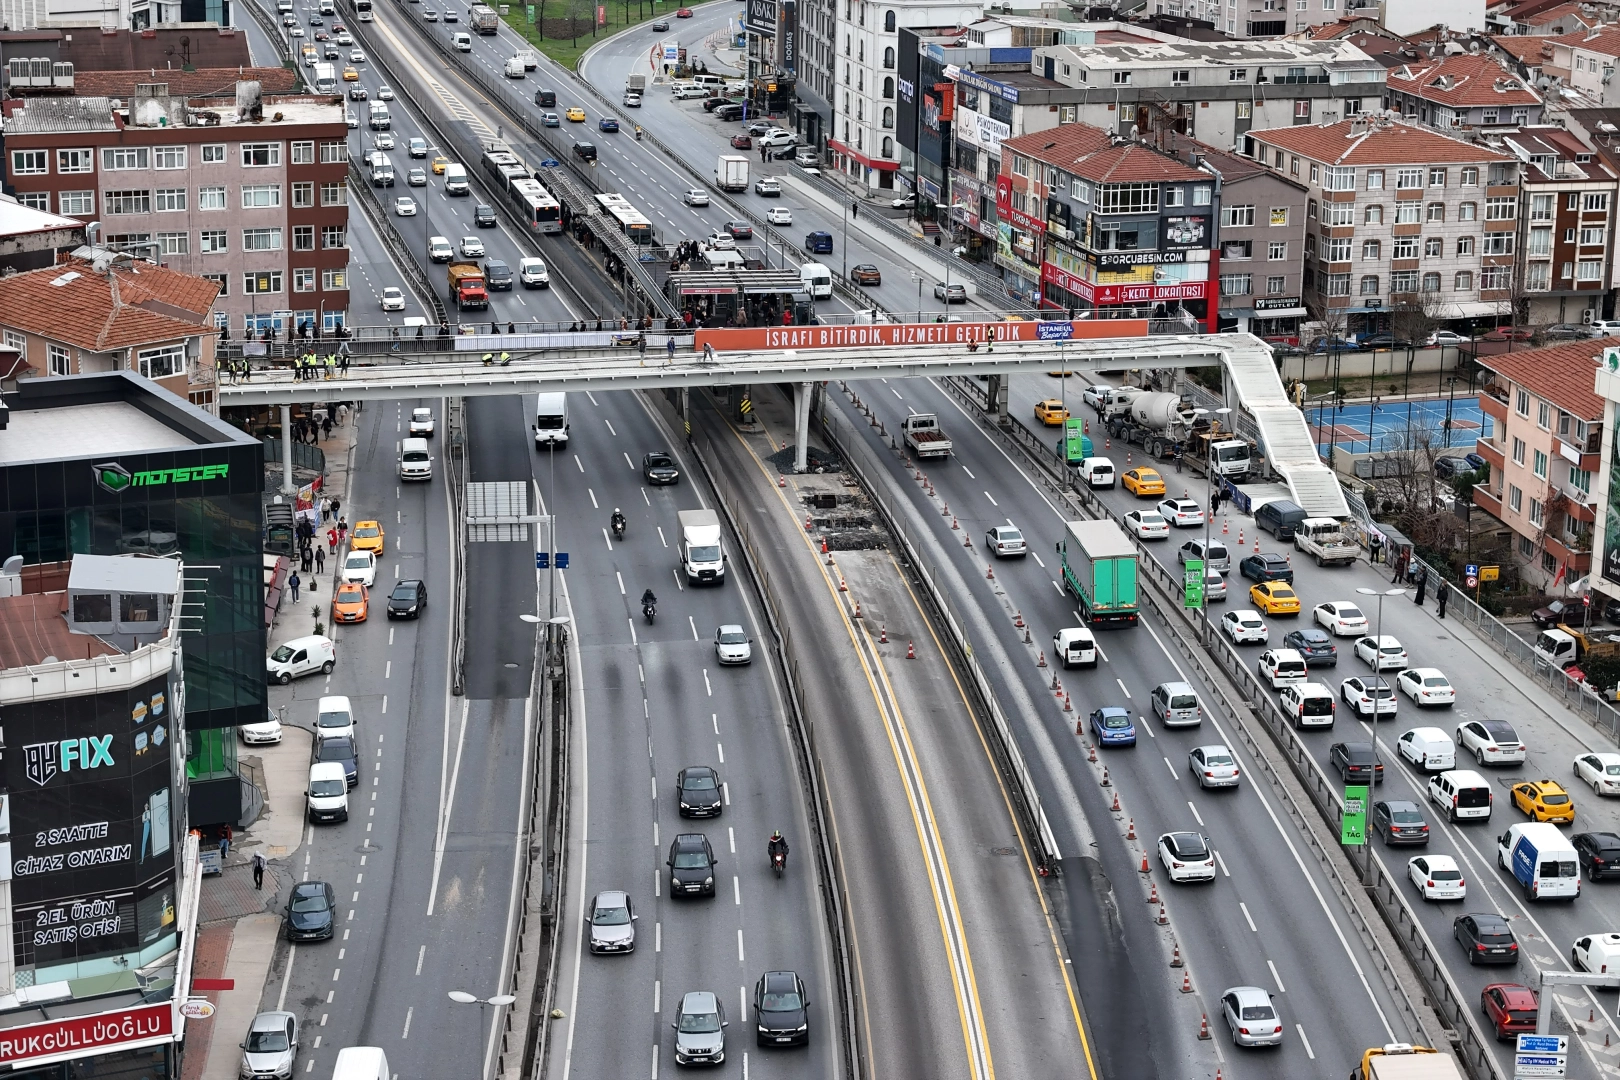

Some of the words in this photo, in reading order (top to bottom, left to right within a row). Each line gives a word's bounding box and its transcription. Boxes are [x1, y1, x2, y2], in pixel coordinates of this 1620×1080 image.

[785, 31, 793, 61] DOĞTAŞ
[898, 74, 914, 98] bambi
[976, 116, 1009, 137] PSİKOTEKNİK
[1128, 288, 1150, 299] KENT
[1154, 285, 1201, 298] LOKANTASI
[766, 328, 812, 346] İSRAFI
[820, 326, 886, 345] BİTİRDİK,
[892, 324, 948, 343] HİZMETİ
[956, 323, 1020, 341] GETİDİK
[132, 463, 229, 487] MONSTER
[60, 734, 115, 773] FIX
[35, 833, 47, 847] 2
[48, 821, 109, 845] SAATTE
[14, 855, 63, 876] CİHAZ
[67, 844, 132, 867] ONARIM
[71, 900, 115, 920] ÜRÜN
[33, 927, 78, 946] SATIŞ
[80, 915, 121, 939] OFİSİ
